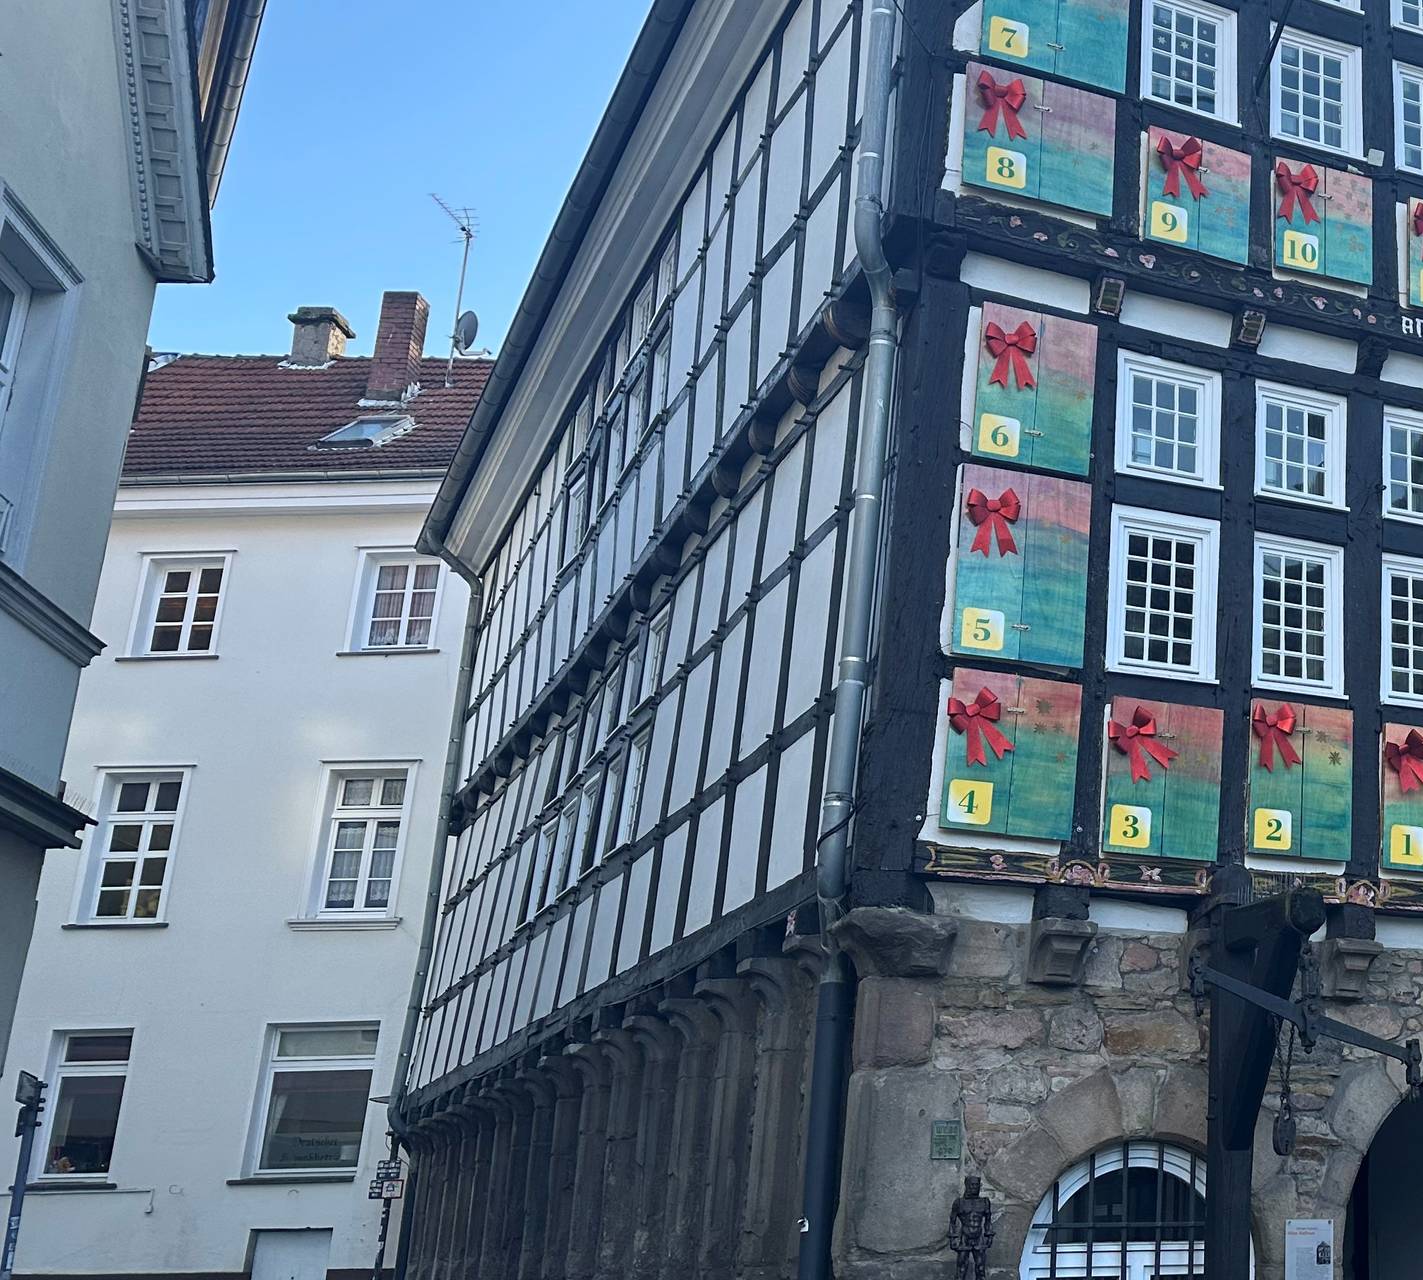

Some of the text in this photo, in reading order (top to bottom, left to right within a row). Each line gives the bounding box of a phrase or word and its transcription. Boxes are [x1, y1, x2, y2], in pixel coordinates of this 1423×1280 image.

[1001, 27, 1018, 48] 7
[996, 156, 1015, 179] 8
[1161, 212, 1178, 232] 9
[1289, 239, 1317, 263] 10
[990, 425, 1009, 447] 6
[973, 618, 991, 641] 5
[958, 789, 978, 815] 4
[1122, 814, 1140, 839] 3
[1265, 818, 1283, 842] 2
[1401, 834, 1412, 856] 1
